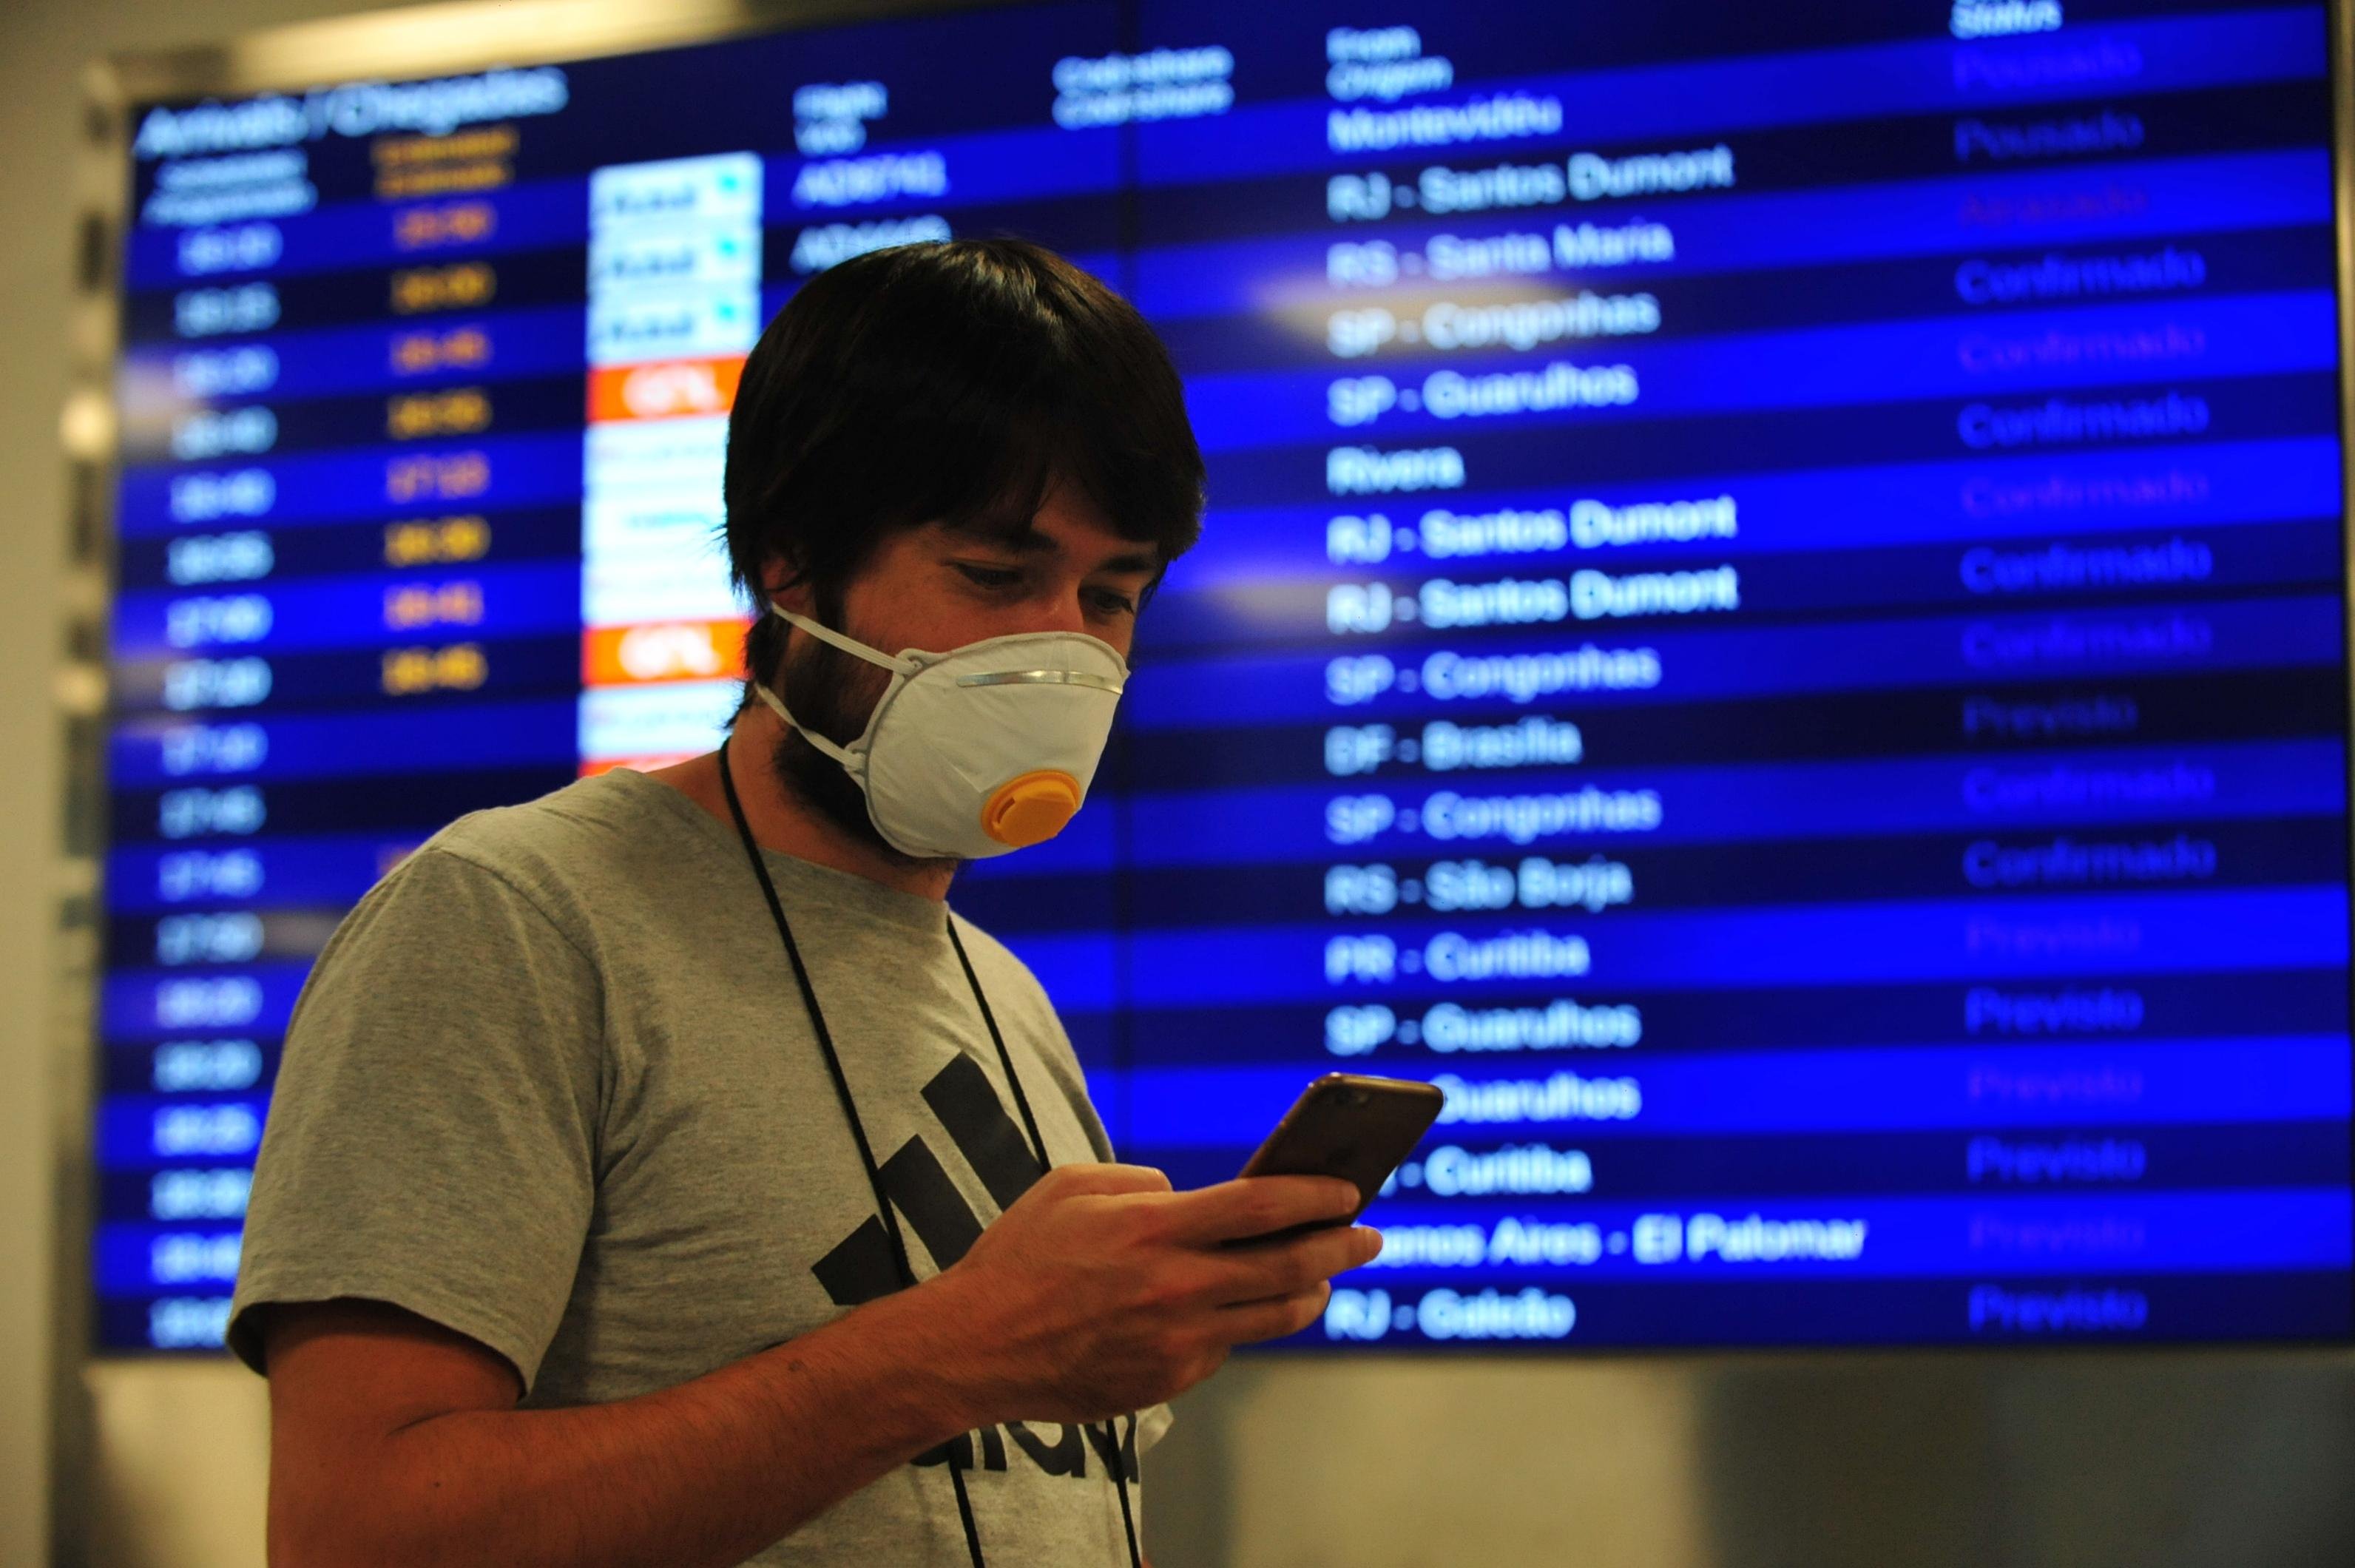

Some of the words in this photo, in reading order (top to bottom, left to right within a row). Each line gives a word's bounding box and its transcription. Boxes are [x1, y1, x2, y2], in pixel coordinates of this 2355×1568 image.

[1328, 174, 1393, 219] RJ
[1419, 166, 1566, 213] Santos
[1567, 147, 1732, 200] Dumont
[1427, 234, 1550, 280] Santa
[1553, 220, 1674, 268] Maria
[1955, 246, 2206, 304] Confirmado
[1328, 308, 1396, 357] SP
[1423, 292, 1661, 351] Congonhas
[1328, 376, 1397, 425] SP
[1422, 362, 1638, 418] Guarulhos
[1958, 388, 2210, 448] Confirmado
[1326, 515, 1393, 565] RJ
[1419, 510, 1568, 558] Santos
[1570, 496, 1737, 548] Dumont
[1960, 536, 2213, 592] Confirmado
[1323, 584, 1393, 632] RJ
[1419, 579, 1568, 628] Santos
[1570, 567, 1738, 619] Dumont
[1326, 655, 1396, 704] SP
[1421, 647, 1660, 702] Congonhas
[1963, 761, 2214, 814] Confirmado
[1327, 796, 1396, 843] SP
[1421, 788, 1661, 843] Congonhas
[1964, 833, 2217, 888] Confirmado
[1425, 932, 1590, 980] Curitiba
[1326, 1006, 1396, 1055] SP
[1422, 1001, 1641, 1052] Guarulhos
[1965, 986, 2143, 1034] Previsto
[1425, 1146, 1592, 1195] Curitiba
[1967, 1135, 2146, 1182] Previsto
[1487, 1218, 1602, 1264] Aires
[1686, 1214, 1865, 1260] Palomar
[1325, 1285, 1392, 1339] RJ
[1968, 1283, 2149, 1331] Previsto
